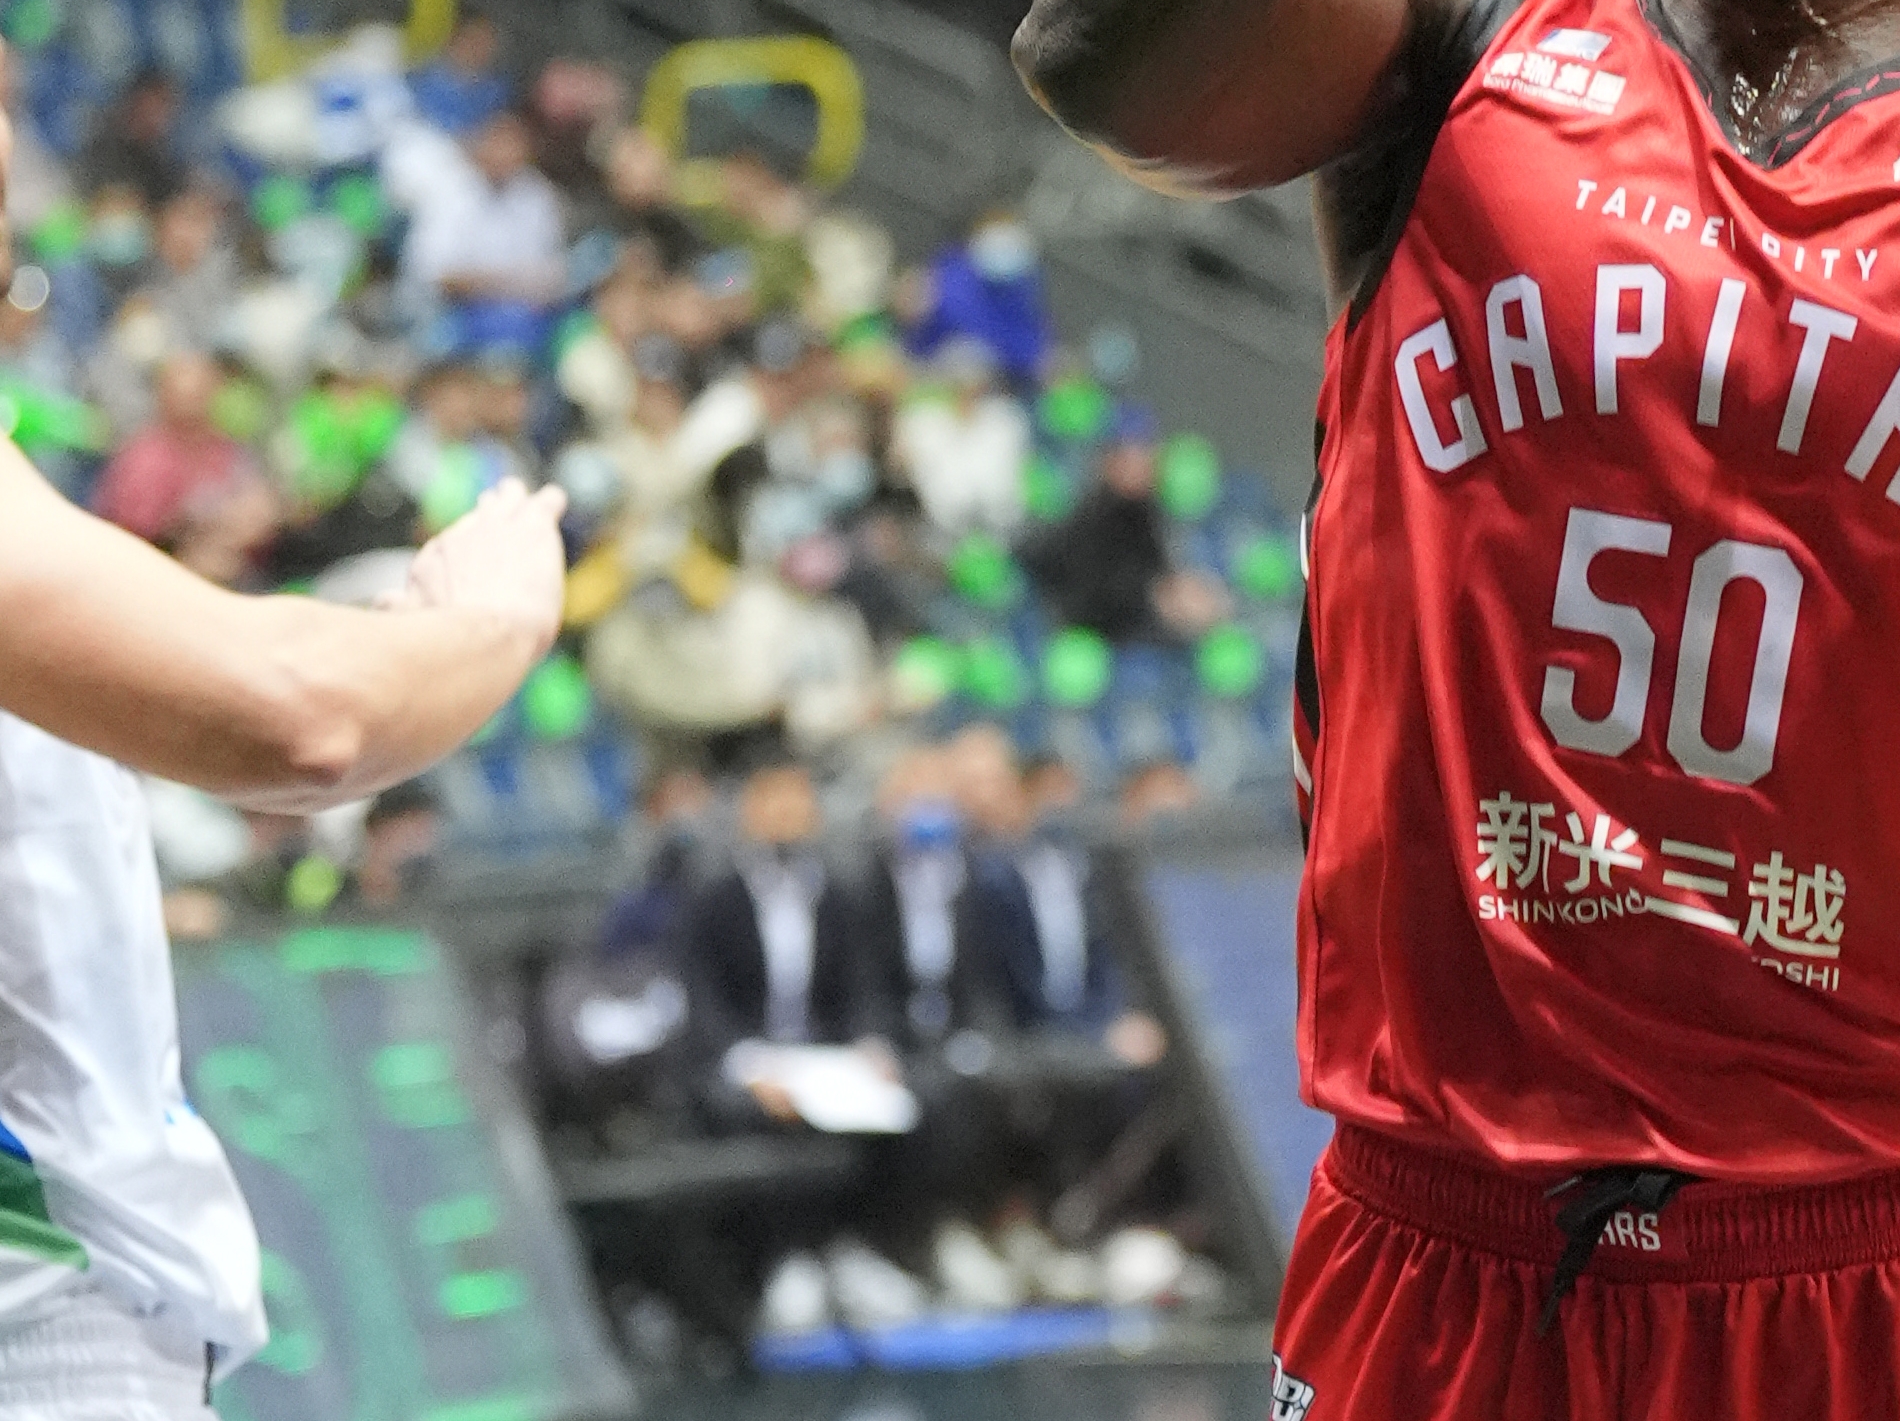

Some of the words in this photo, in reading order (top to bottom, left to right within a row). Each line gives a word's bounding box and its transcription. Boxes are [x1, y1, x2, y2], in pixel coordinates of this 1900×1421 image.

[1540, 506, 1805, 787] 50
[1475, 790, 1847, 960] 新光三越
[1597, 1210, 1662, 1252] ARS
